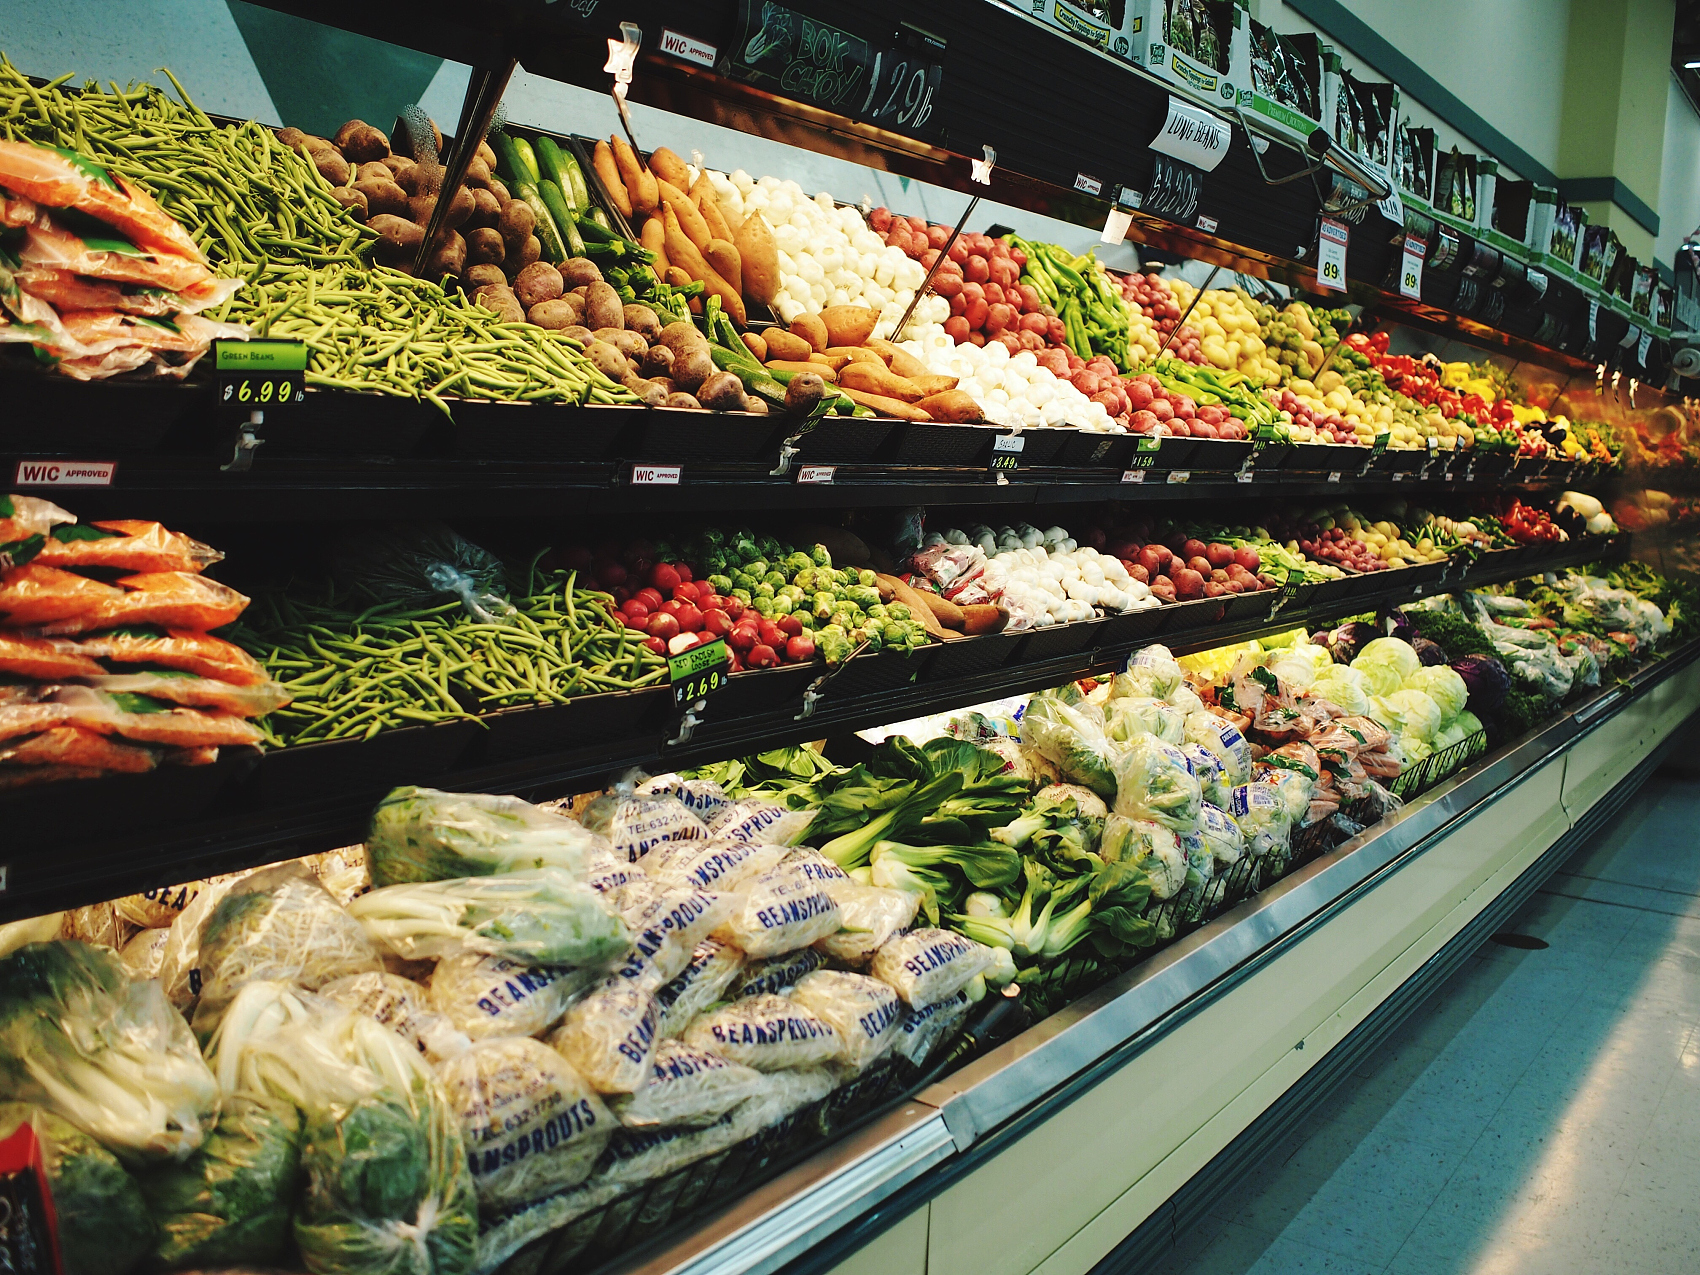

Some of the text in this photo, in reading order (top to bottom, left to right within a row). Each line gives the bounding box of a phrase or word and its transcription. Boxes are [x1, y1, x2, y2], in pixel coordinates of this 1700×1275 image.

[664, 35, 714, 61] WIC APPROVED
[796, 20, 849, 72] BOK
[780, 60, 864, 105] CHOY
[1167, 112, 1221, 150] LONG BEANS
[221, 351, 275, 361] GREEN BEANS
[23, 465, 109, 482] WIC APPROVED
[635, 470, 678, 482] WIC APPROVED
[801, 469, 816, 480] WIC
[674, 657, 688, 668] RED
[691, 658, 711, 672] LOOSE
